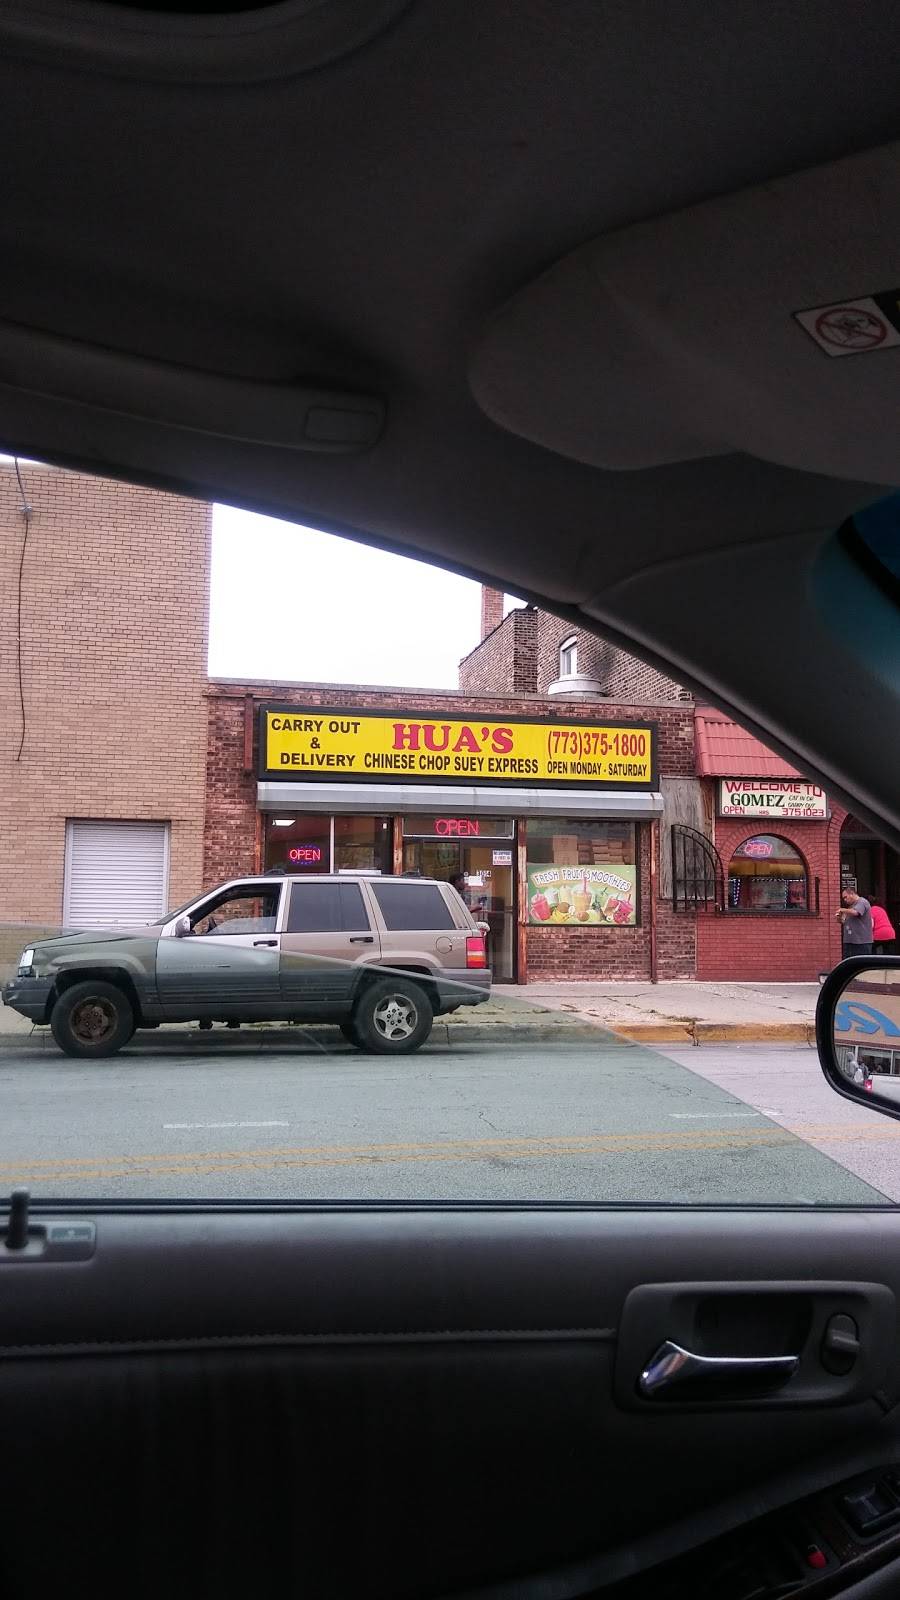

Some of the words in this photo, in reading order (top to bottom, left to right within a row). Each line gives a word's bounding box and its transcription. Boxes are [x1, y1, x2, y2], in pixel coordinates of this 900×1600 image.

[271, 718, 323, 732] CARRY
[328, 721, 360, 734] OUT
[310, 737, 320, 749] &
[392, 723, 514, 754] HUA'S
[547, 731, 646, 760] (773)375-1800
[280, 752, 356, 767] DELIVERY
[364, 753, 415, 769] CHINESE
[419, 755, 450, 771] CHOP
[454, 756, 485, 772] SUEY
[488, 757, 539, 774] EXPRESS
[547, 761, 568, 775] OPEN
[569, 762, 602, 776] MONDAY
[608, 763, 647, 777] SATURDAY
[725, 781, 801, 794] WELCOME
[730, 793, 785, 807] GOMEZ
[723, 806, 745, 814] OPEN
[435, 818, 480, 836] OPEN
[289, 849, 321, 861] OPEN
[745, 843, 772, 855] OPEN
[534, 871, 560, 885] FRESH
[561, 869, 584, 880] FRUIT
[583, 869, 631, 891] SMOOTHIES
